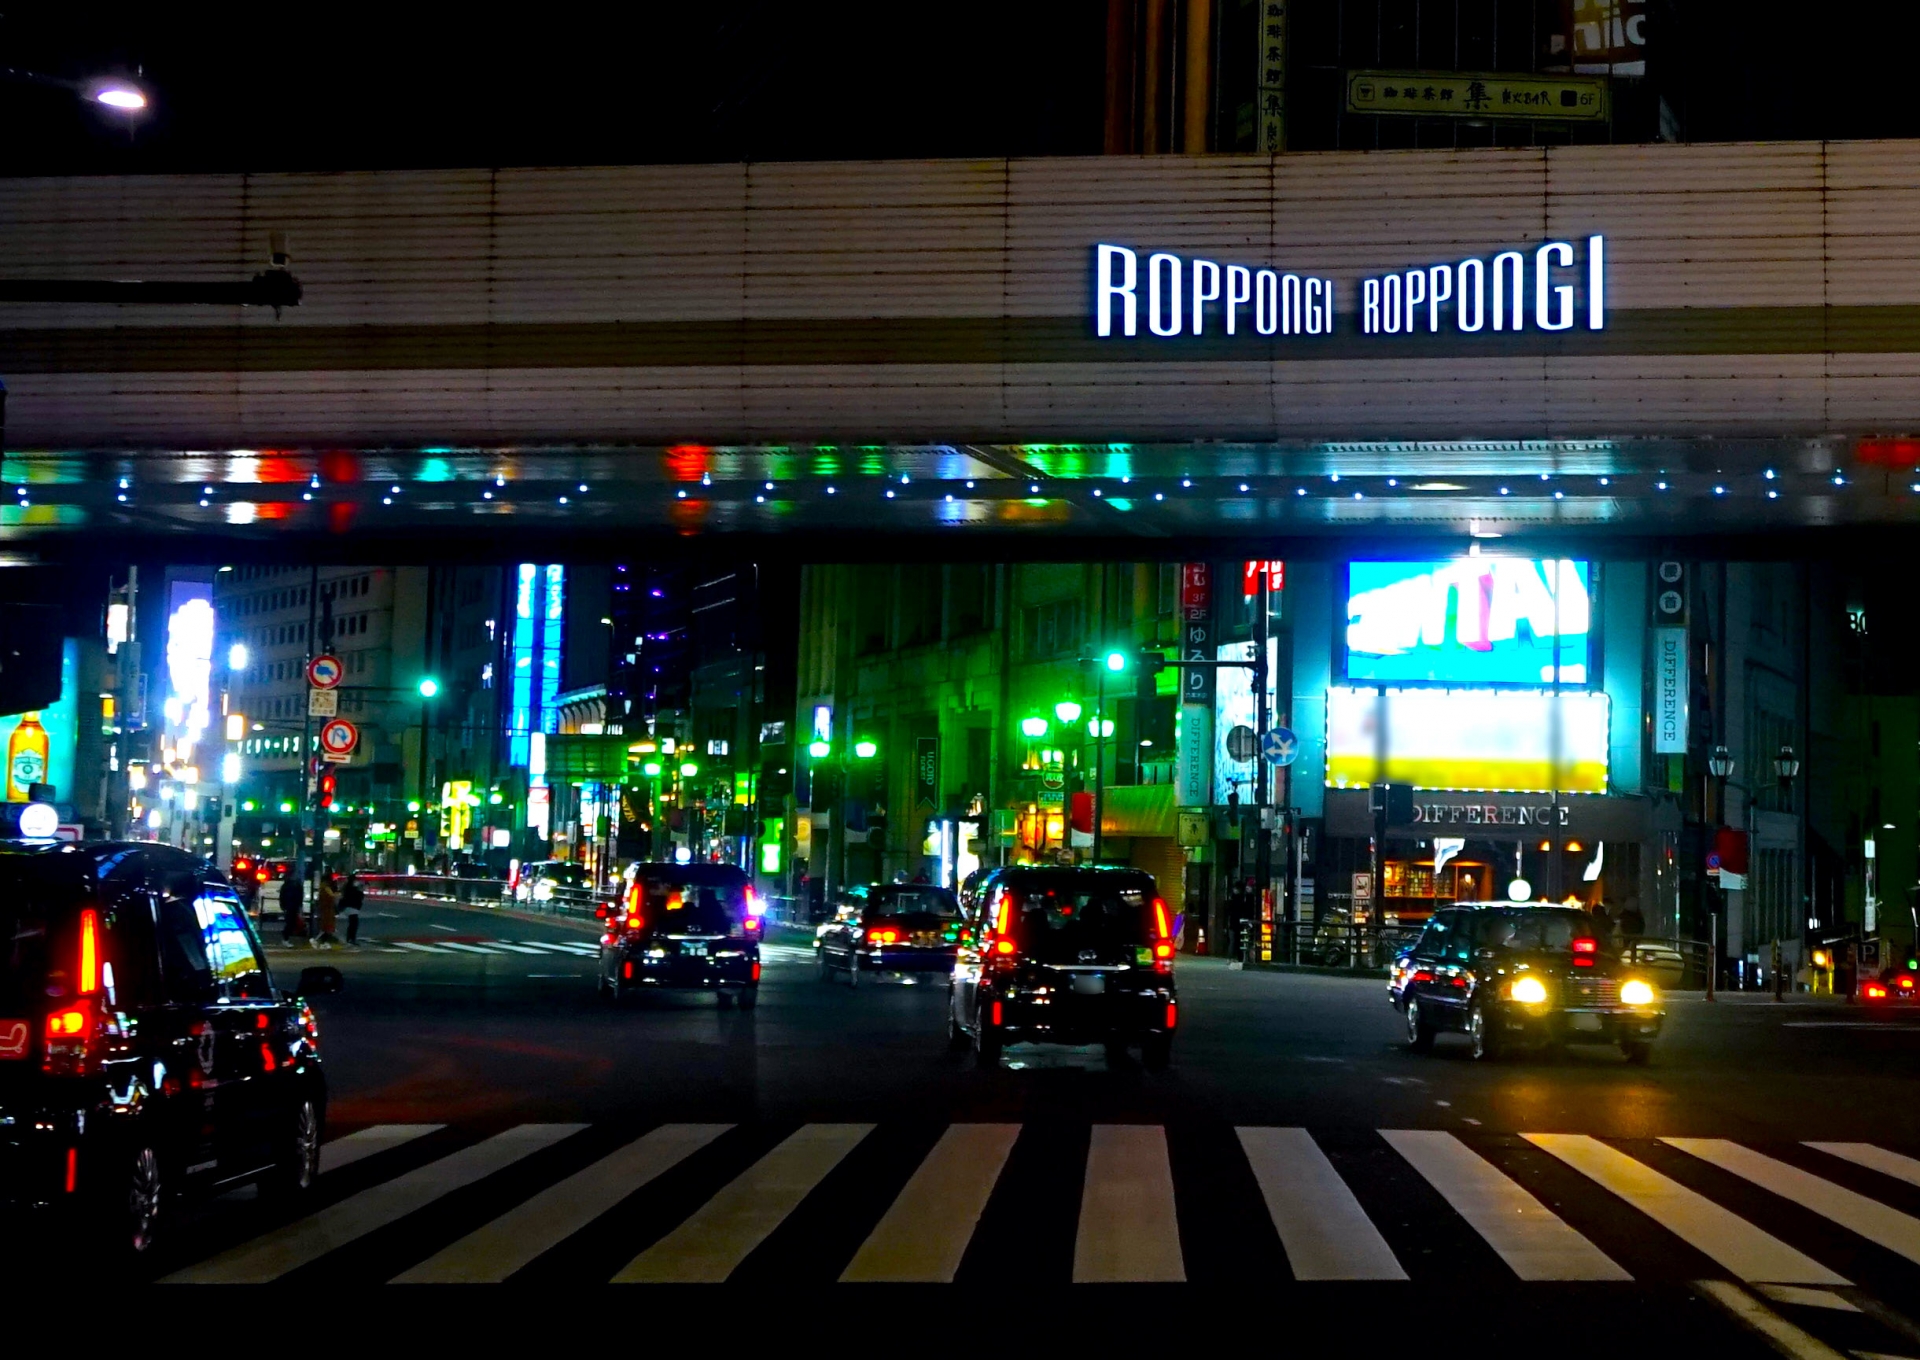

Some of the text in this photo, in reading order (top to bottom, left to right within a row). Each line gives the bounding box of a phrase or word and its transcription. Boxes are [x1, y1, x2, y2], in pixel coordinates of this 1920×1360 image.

[1580, 92, 1597, 106] 6F
[1096, 242, 1333, 338] ROPPONGI
[1362, 234, 1605, 336] ROPPONGI
[1189, 609, 1207, 620] 2F
[1192, 593, 1206, 602] 3F
[1664, 640, 1677, 742] DIFFERENCE
[1190, 717, 1201, 798] DIFFERENCE
[1412, 804, 1570, 826] DIFFERENCE
